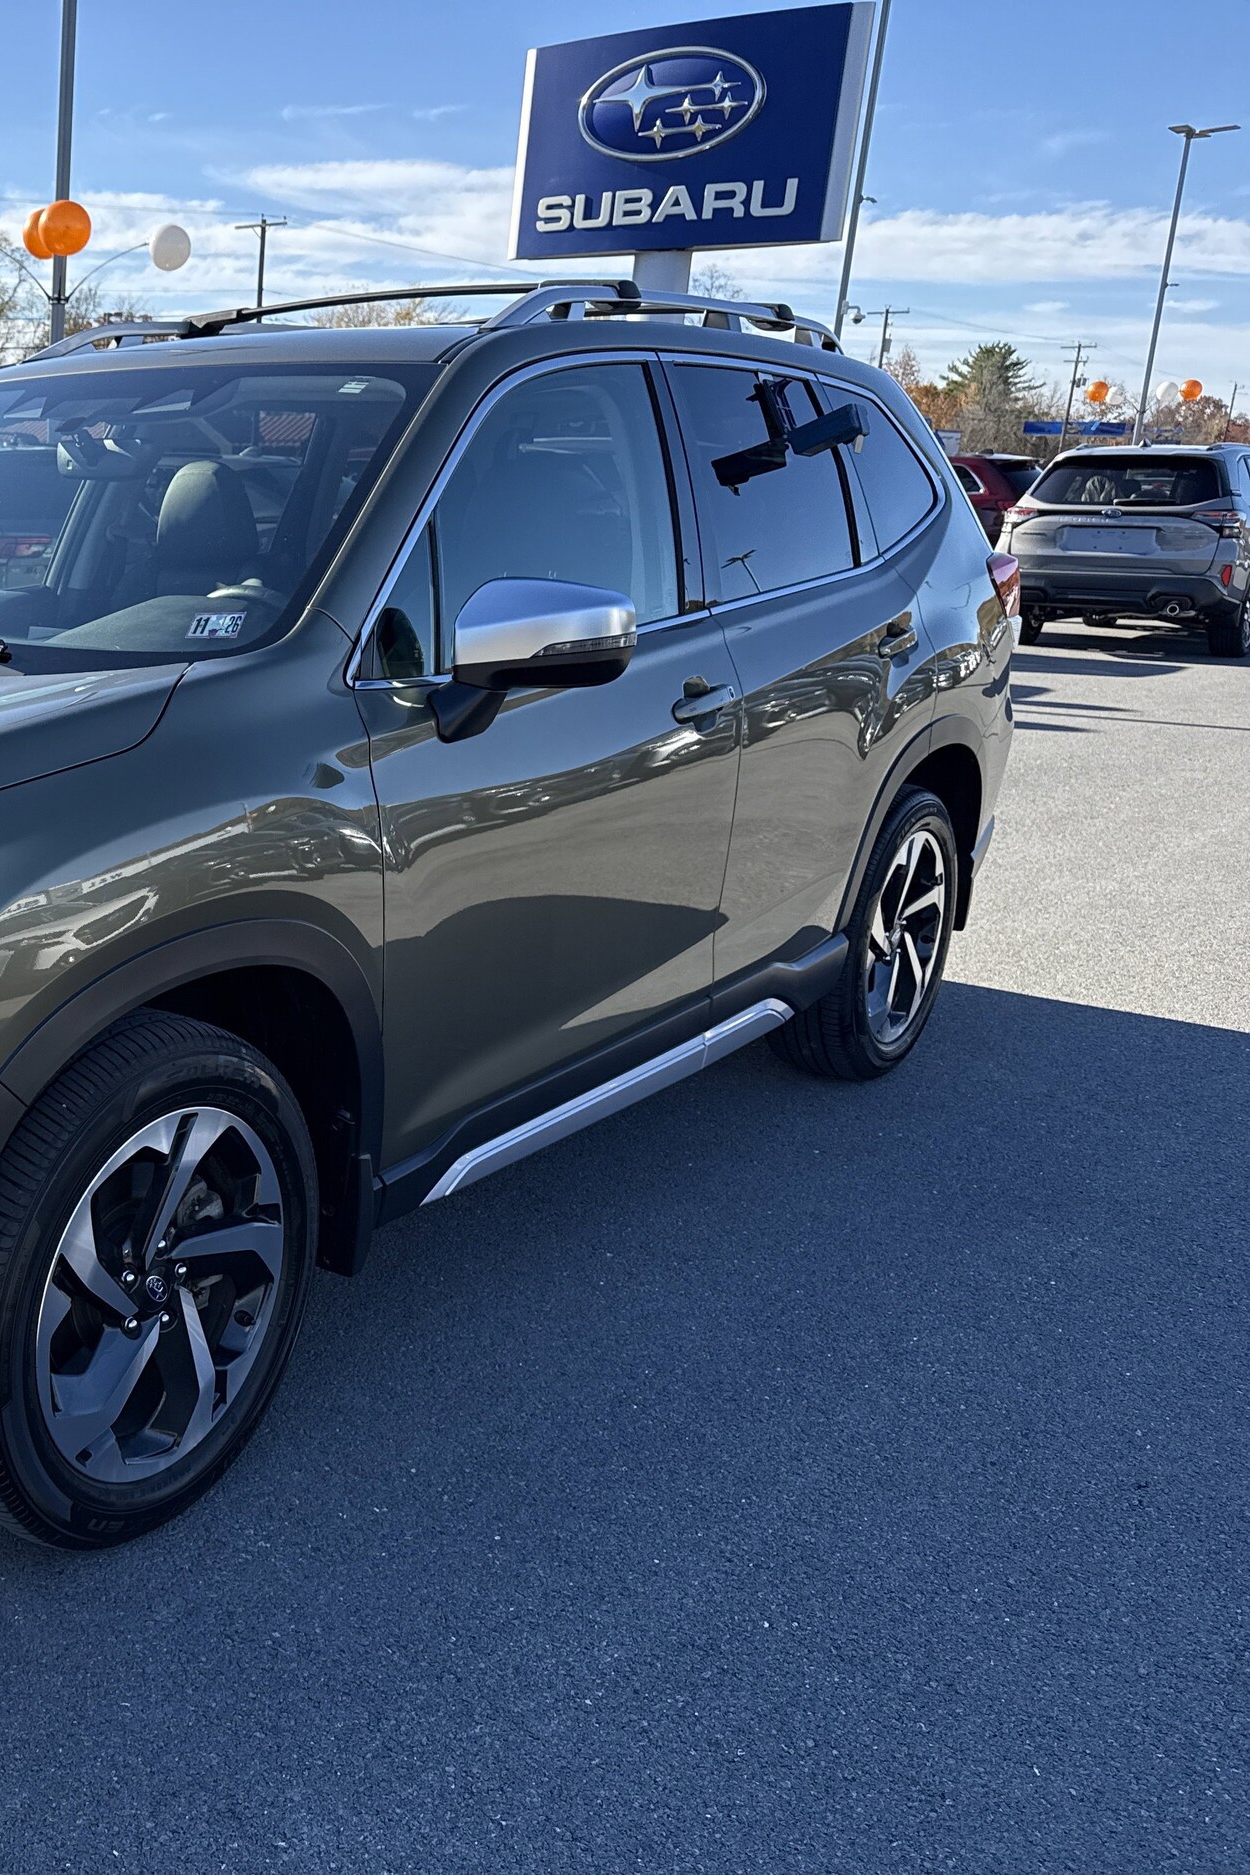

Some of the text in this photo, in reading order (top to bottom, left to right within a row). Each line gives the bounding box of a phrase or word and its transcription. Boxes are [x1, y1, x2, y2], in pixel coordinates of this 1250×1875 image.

[536, 178, 799, 232] SUBARU
[191, 615, 243, 635] 11 26
